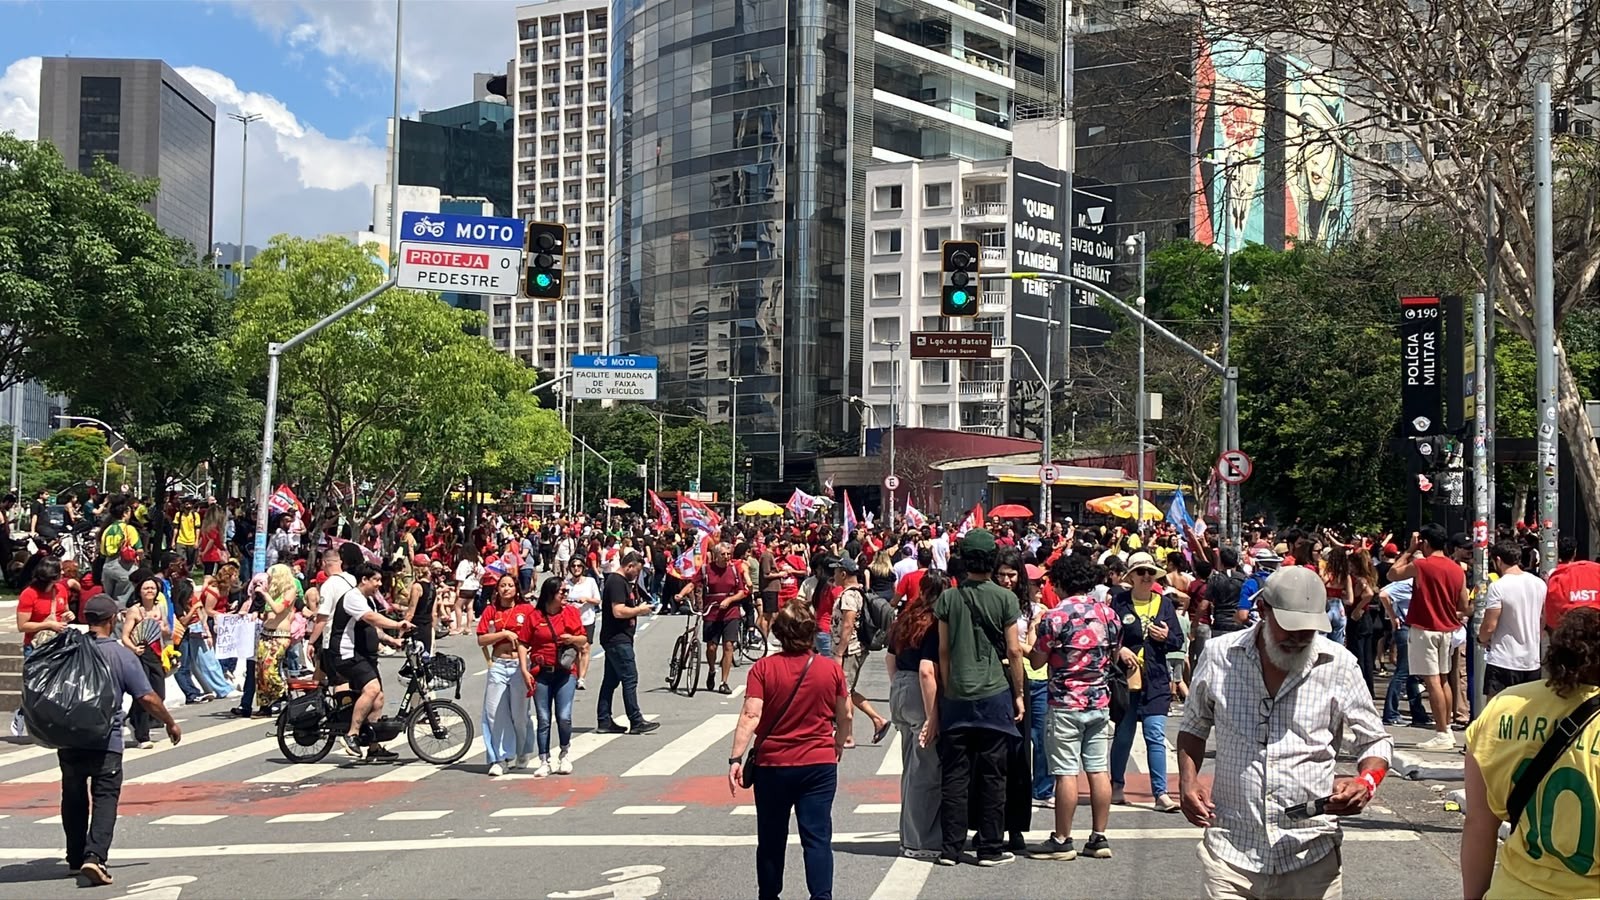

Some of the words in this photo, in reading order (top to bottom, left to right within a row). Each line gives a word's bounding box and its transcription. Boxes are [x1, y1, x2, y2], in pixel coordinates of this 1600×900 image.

[456, 223, 513, 242] MOTO
[1015, 221, 1035, 241] NÃO
[1037, 228, 1063, 250] DEVE,
[410, 251, 484, 268] PROTEJA
[500, 257, 510, 269] O
[1017, 250, 1058, 272] TAMBÉM
[417, 271, 499, 288] PEDESTRE
[1417, 308, 1438, 318] 190
[611, 358, 636, 366] MOTO
[1408, 333, 1419, 386] POLÍCIA
[1423, 332, 1435, 386] MILITAR
[576, 371, 610, 379] FACILITE
[614, 371, 653, 380] MUDANÇA
[606, 387, 645, 395] VEÍCULOS
[1046, 468, 1053, 480] E
[1228, 457, 1240, 477] E
[1569, 590, 1598, 602] MST
